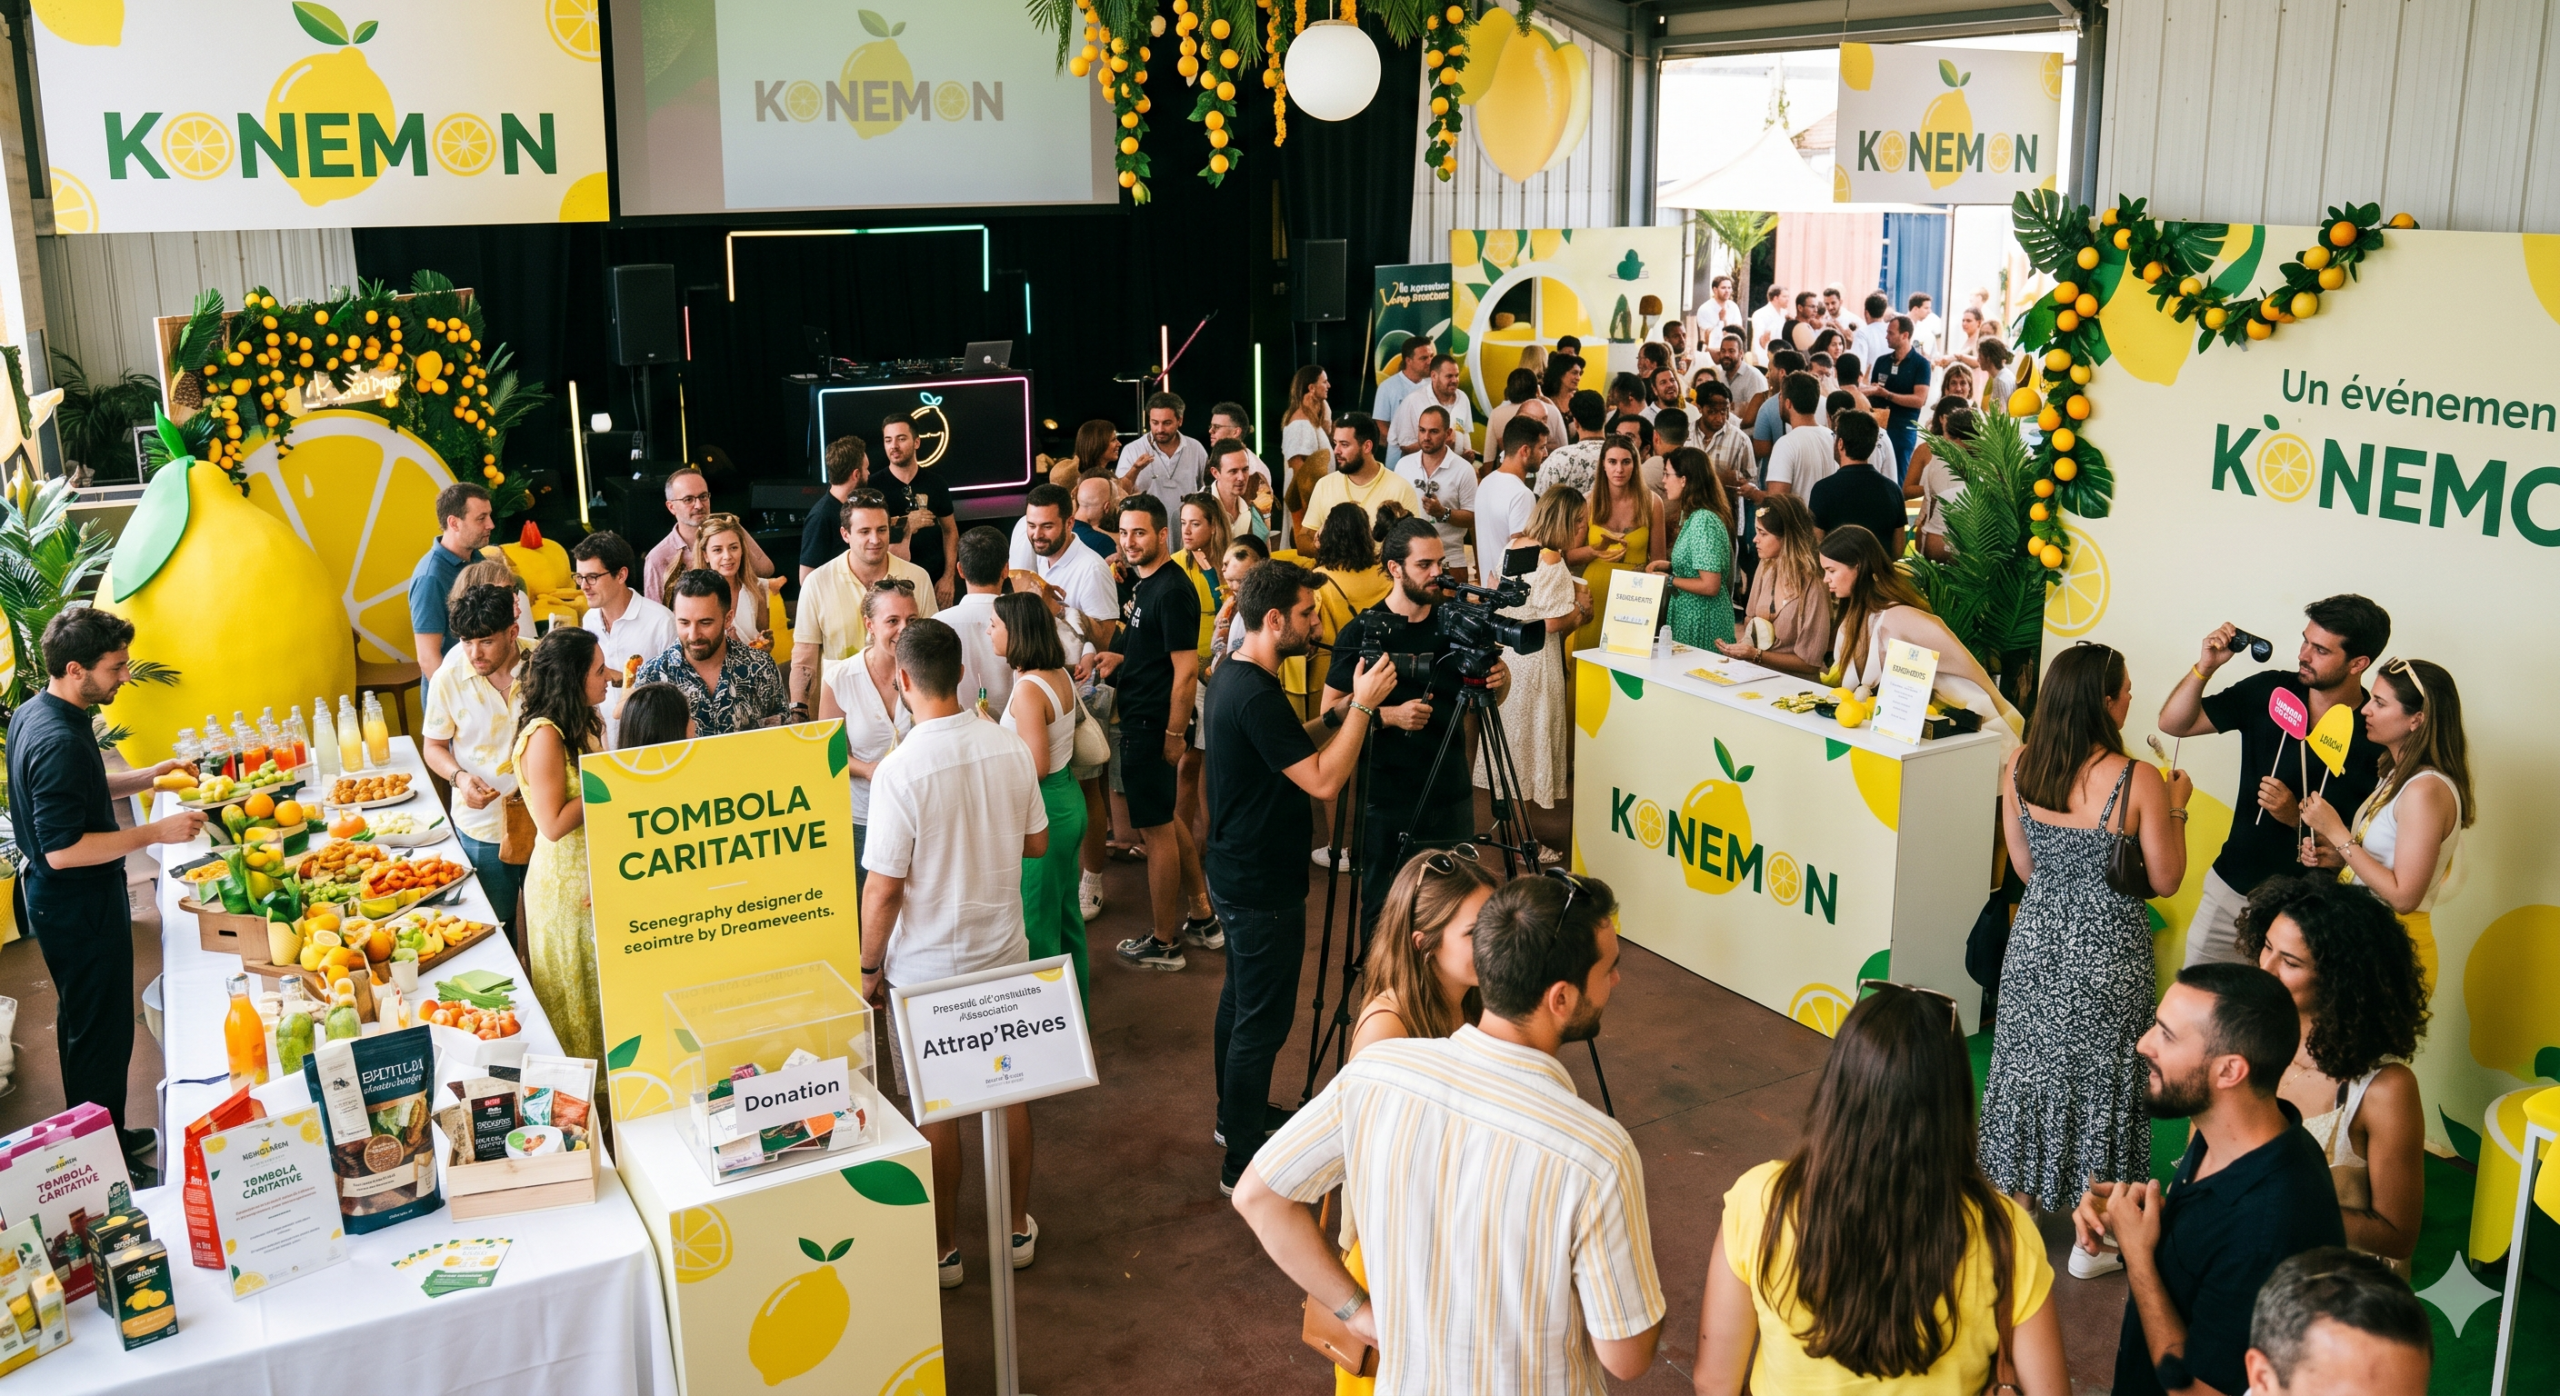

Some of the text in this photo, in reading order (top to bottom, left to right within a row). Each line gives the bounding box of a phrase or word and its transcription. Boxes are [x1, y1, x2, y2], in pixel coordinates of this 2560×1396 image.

[754, 79, 1005, 123] KONEMON
[103, 110, 558, 181] KONEMON
[1857, 129, 2039, 174] KONEMON
[2282, 368, 2330, 406] Un
[627, 784, 812, 839] TOMBOLA
[618, 819, 828, 881] CARITATIVE
[1611, 786, 1839, 926] KONEMON
[623, 905, 836, 955] seoimtre by Dreameveents.
[628, 887, 824, 935] Scenegraphy designer de
[744, 1079, 841, 1113] Donation
[38, 1172, 101, 1205] CARITATIVE
[241, 1172, 304, 1200] CARITATIVE
